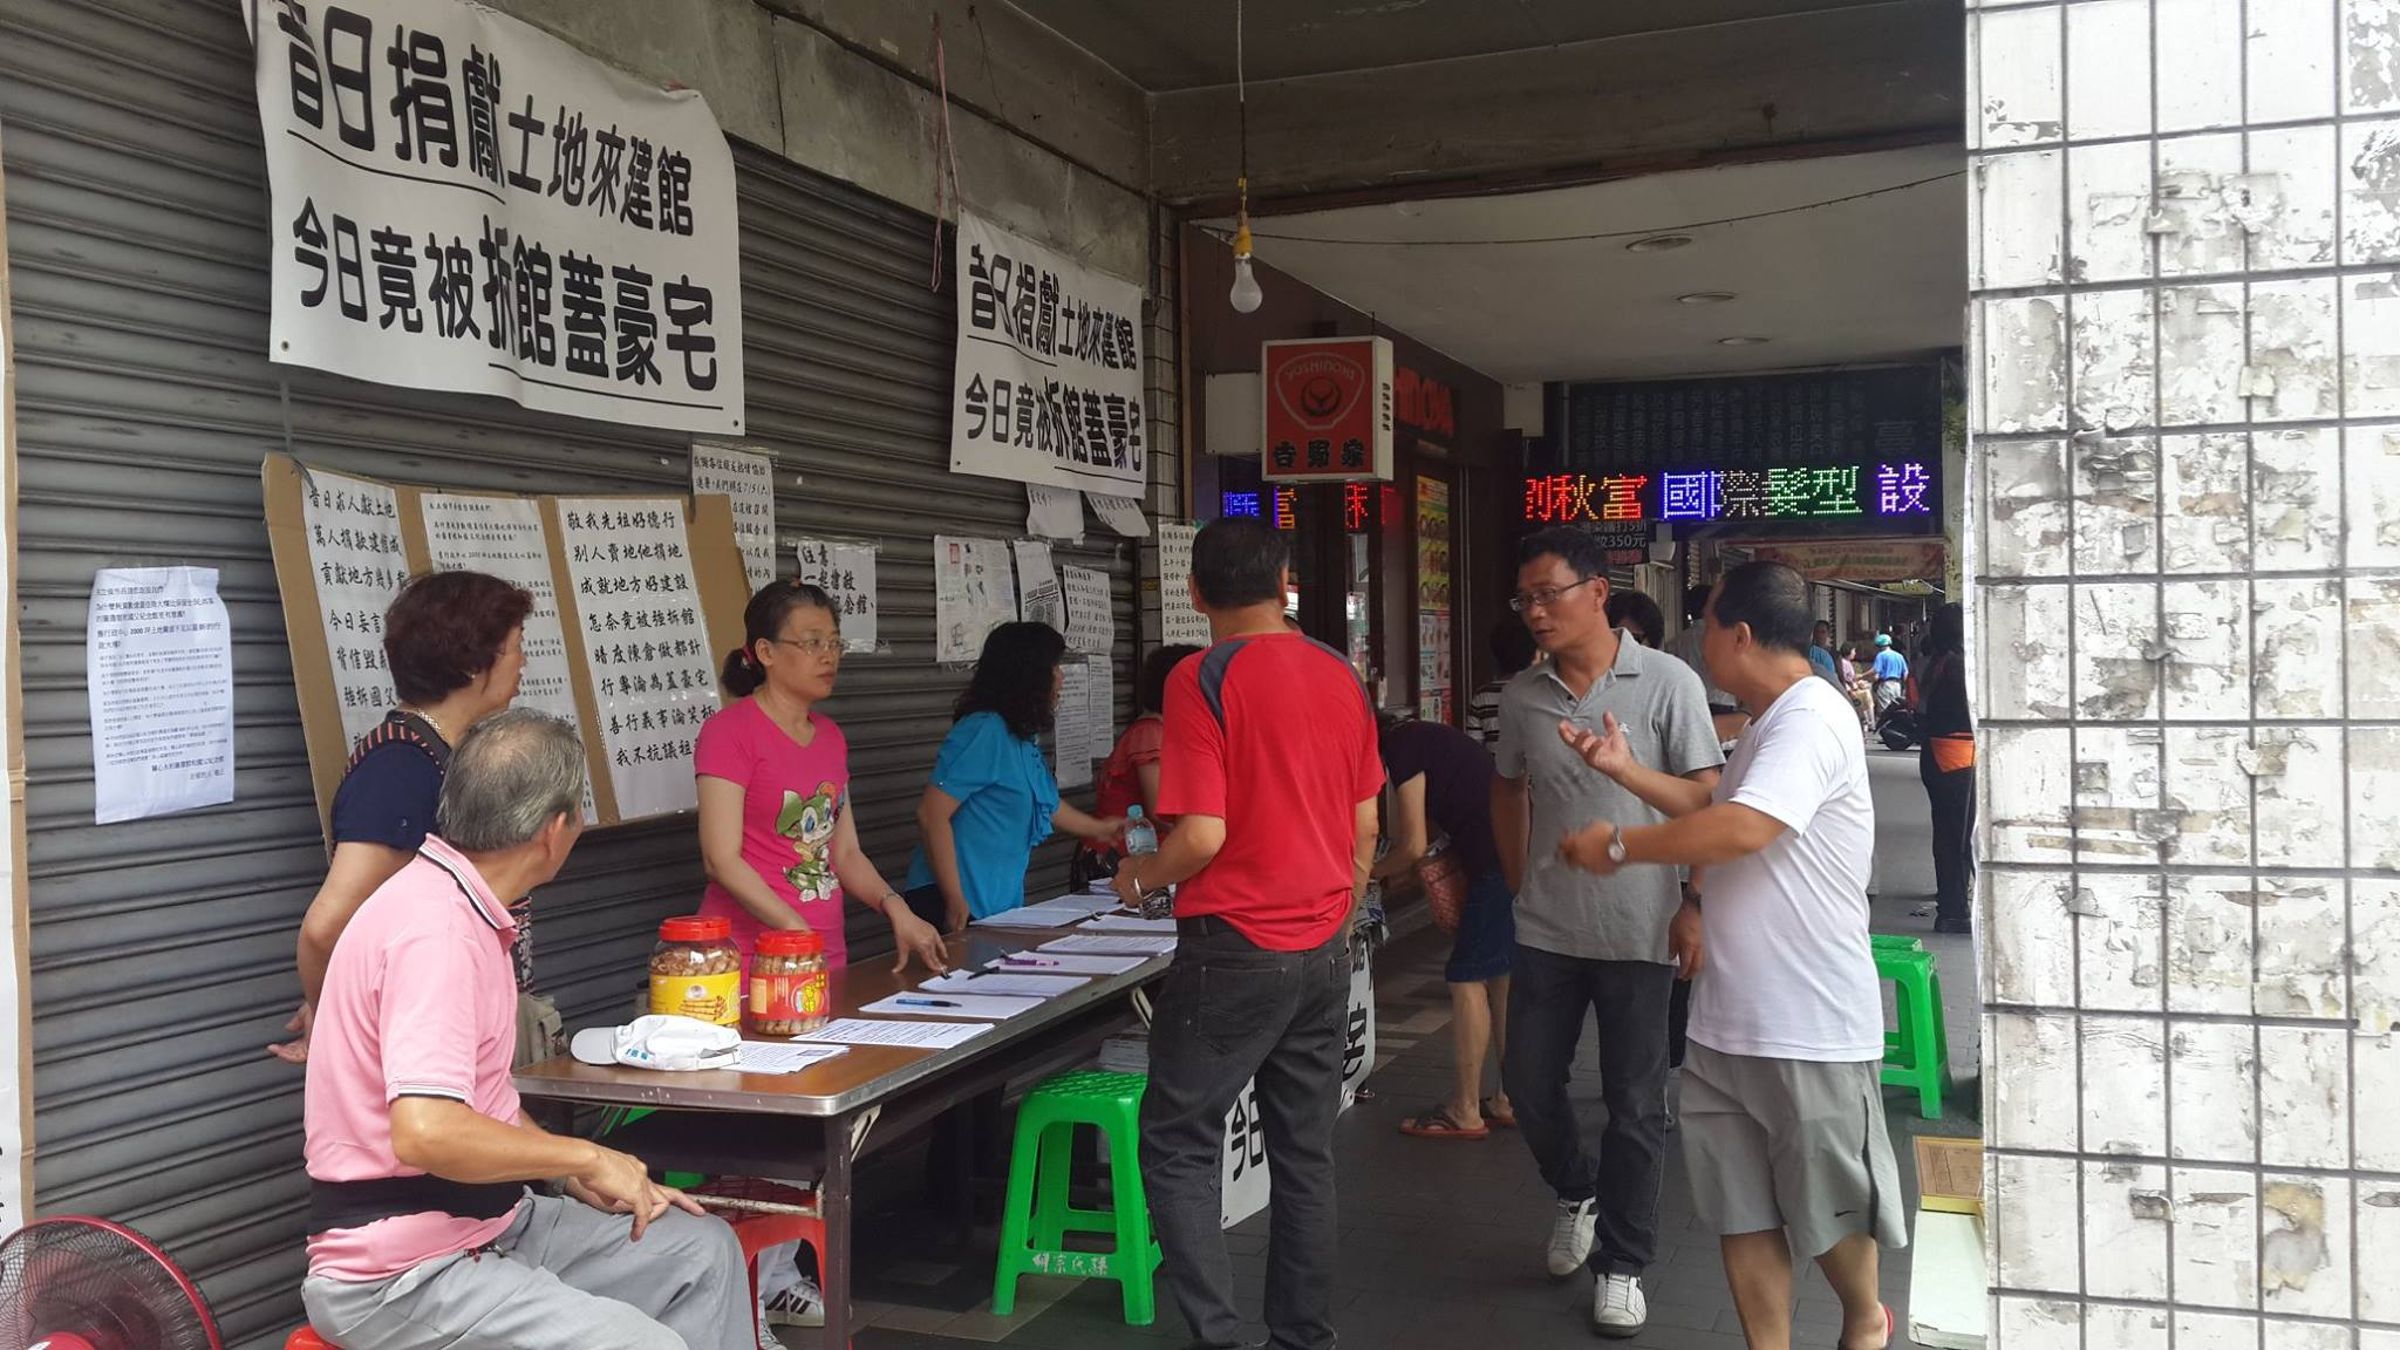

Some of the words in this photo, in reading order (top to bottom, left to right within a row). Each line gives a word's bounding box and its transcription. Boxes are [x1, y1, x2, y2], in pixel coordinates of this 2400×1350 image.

[293, 197, 717, 391] 今日竟被拆館蓋豪宅
[567, 511, 675, 530] 敬我先祖好德行
[581, 573, 689, 595] 成就地方好建設
[616, 738, 698, 767] 我不抗議祖
